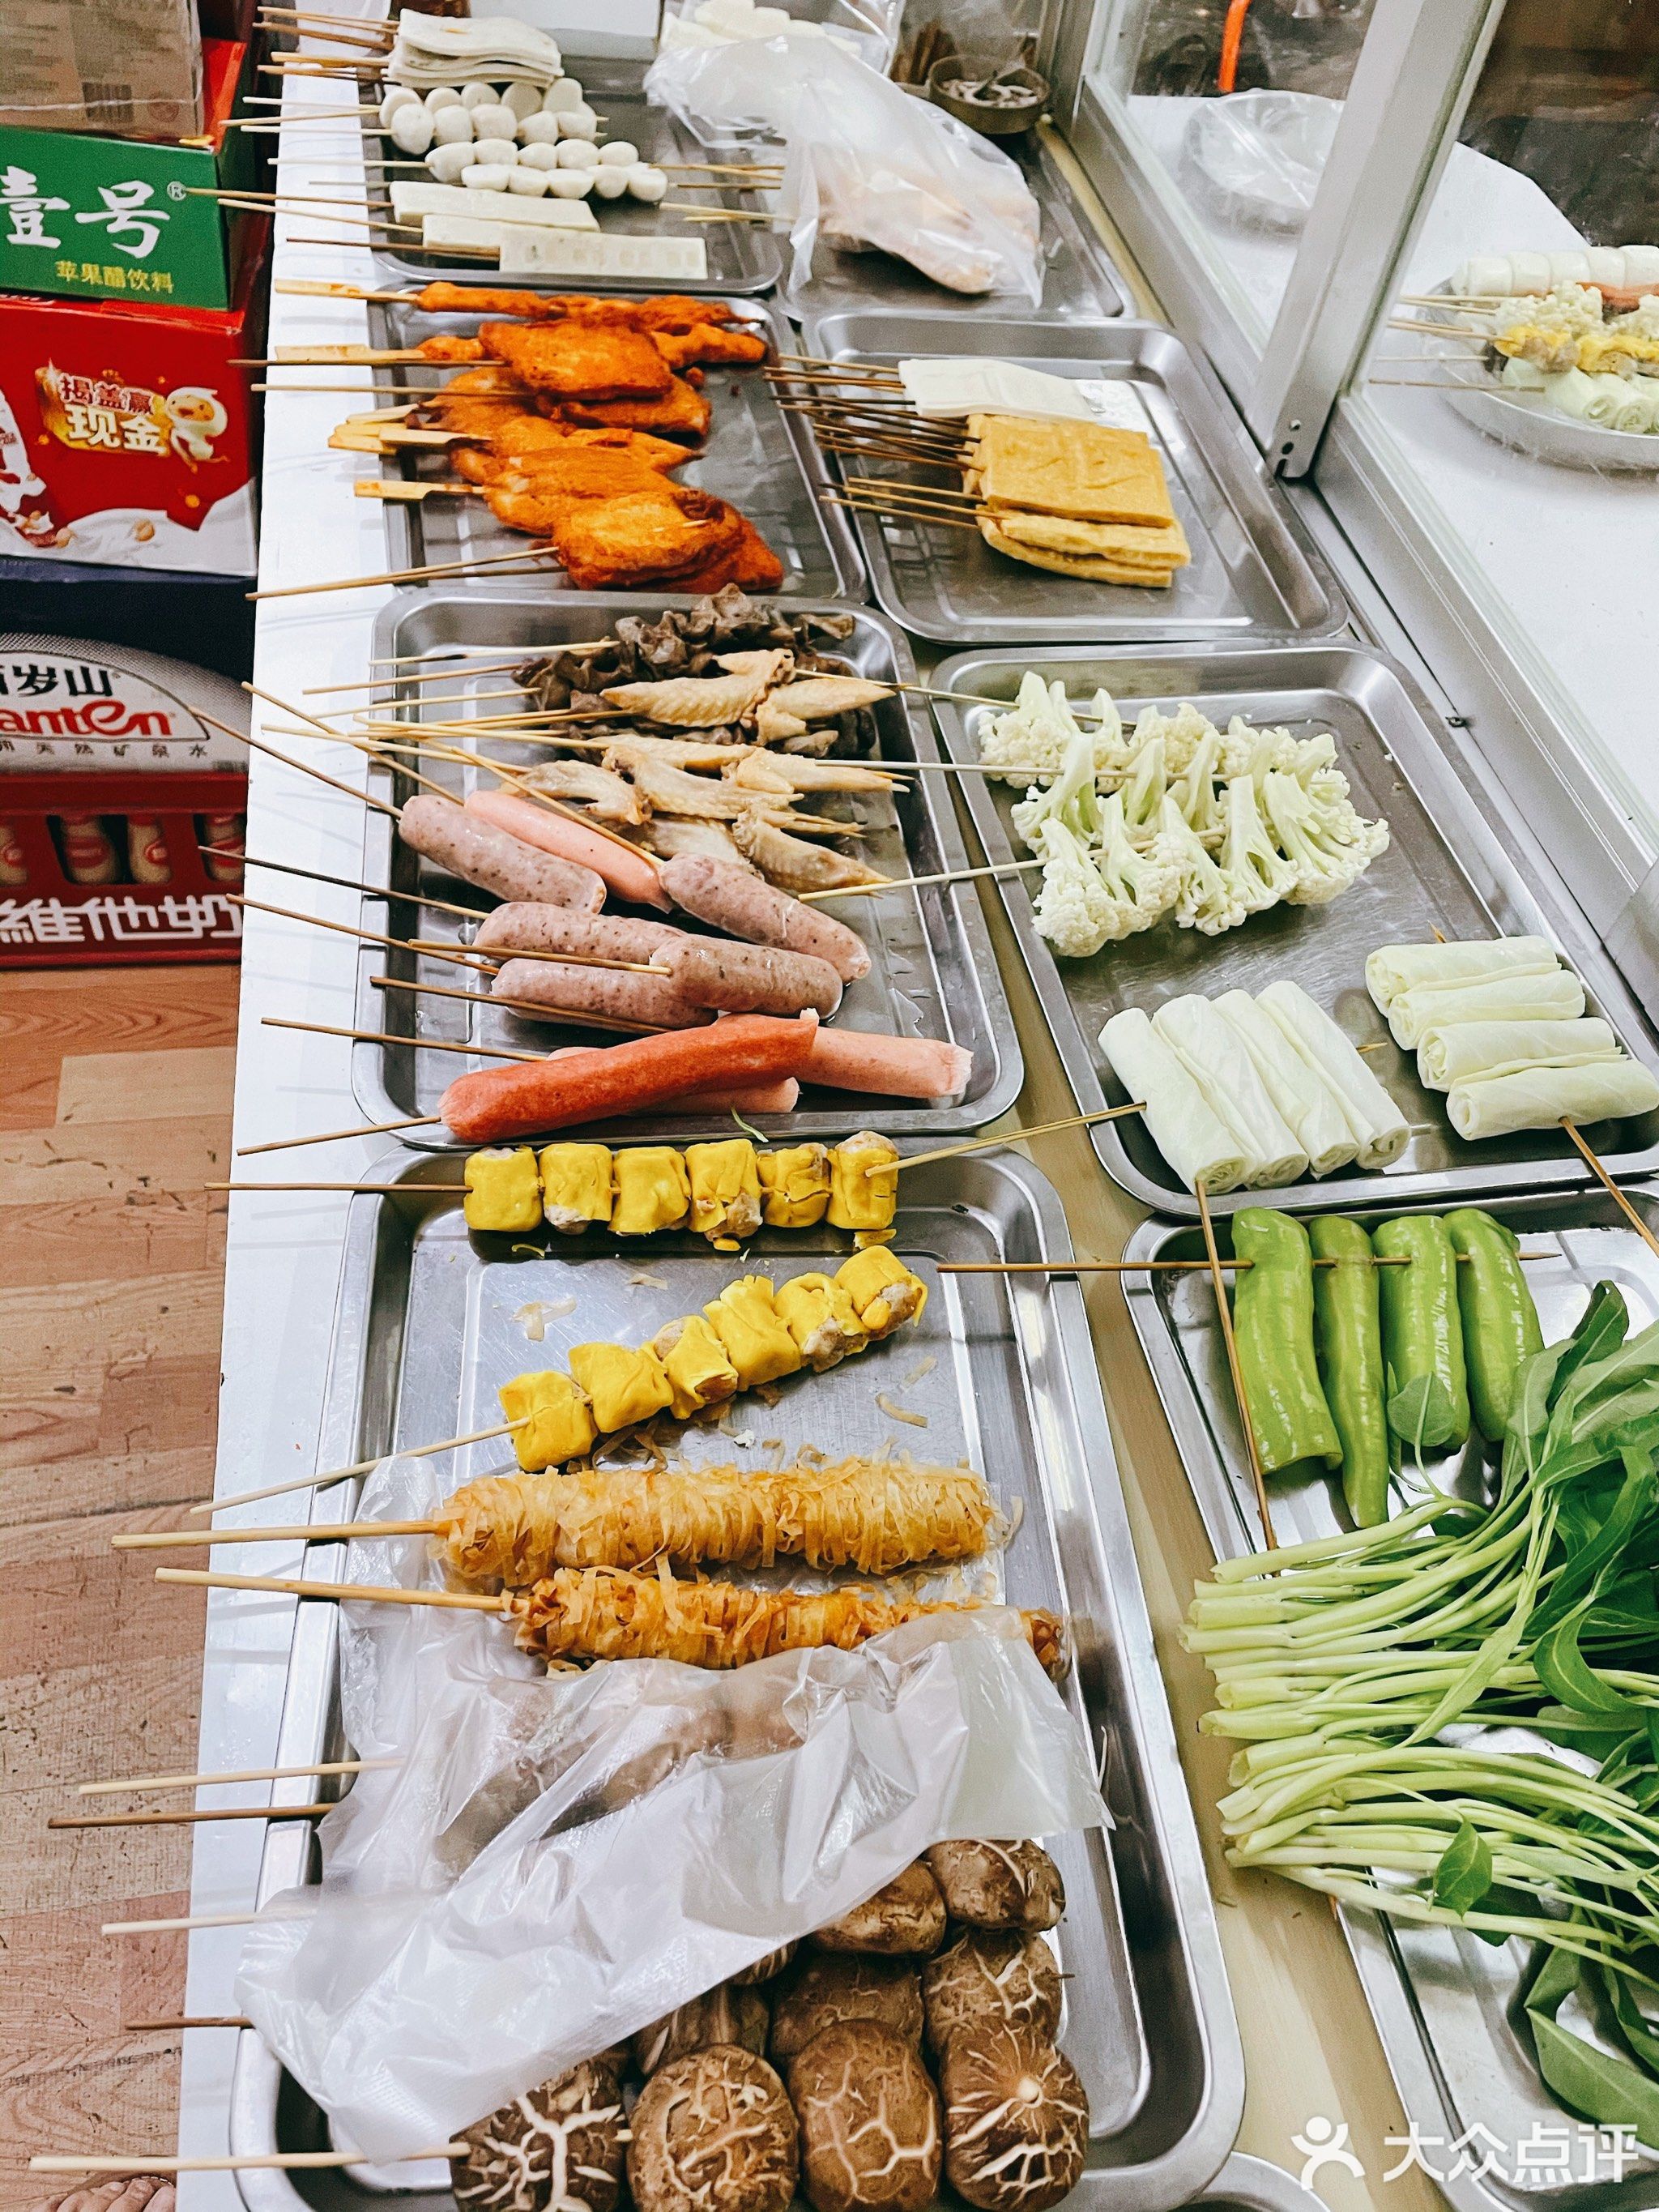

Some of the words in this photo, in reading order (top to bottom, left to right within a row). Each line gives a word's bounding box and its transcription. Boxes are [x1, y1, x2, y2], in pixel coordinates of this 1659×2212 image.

[0, 165, 171, 259] 壹号
[54, 260, 174, 294] 苹果醋饮料
[64, 404, 168, 455] 现金
[0, 895, 242, 944] 維他奶
